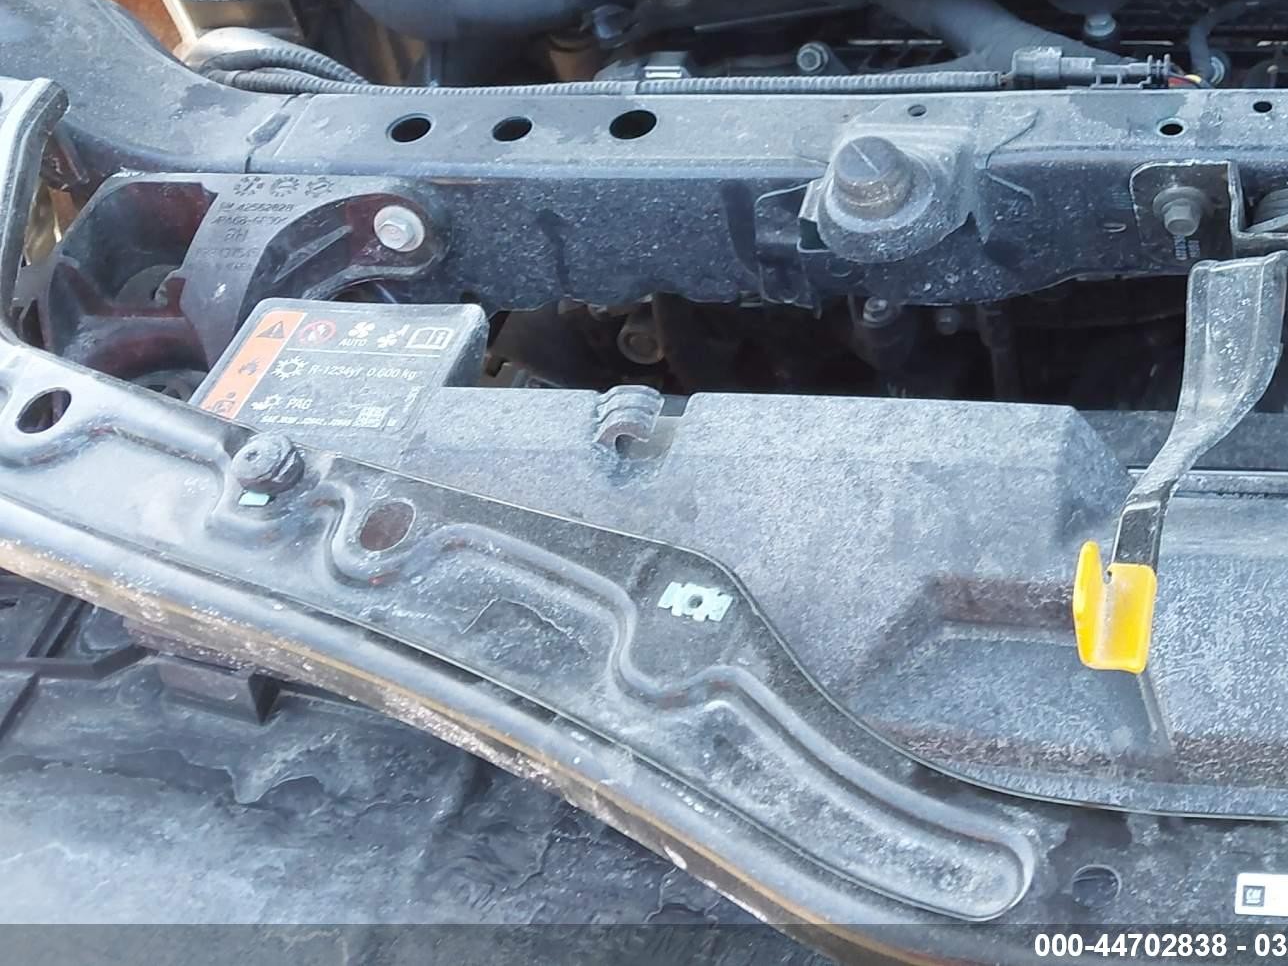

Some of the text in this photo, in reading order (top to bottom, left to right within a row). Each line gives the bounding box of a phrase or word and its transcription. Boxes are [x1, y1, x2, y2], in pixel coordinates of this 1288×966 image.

[338, 338, 368, 347] AUTO
[401, 367, 416, 380] kg
[284, 398, 313, 410] PAG
